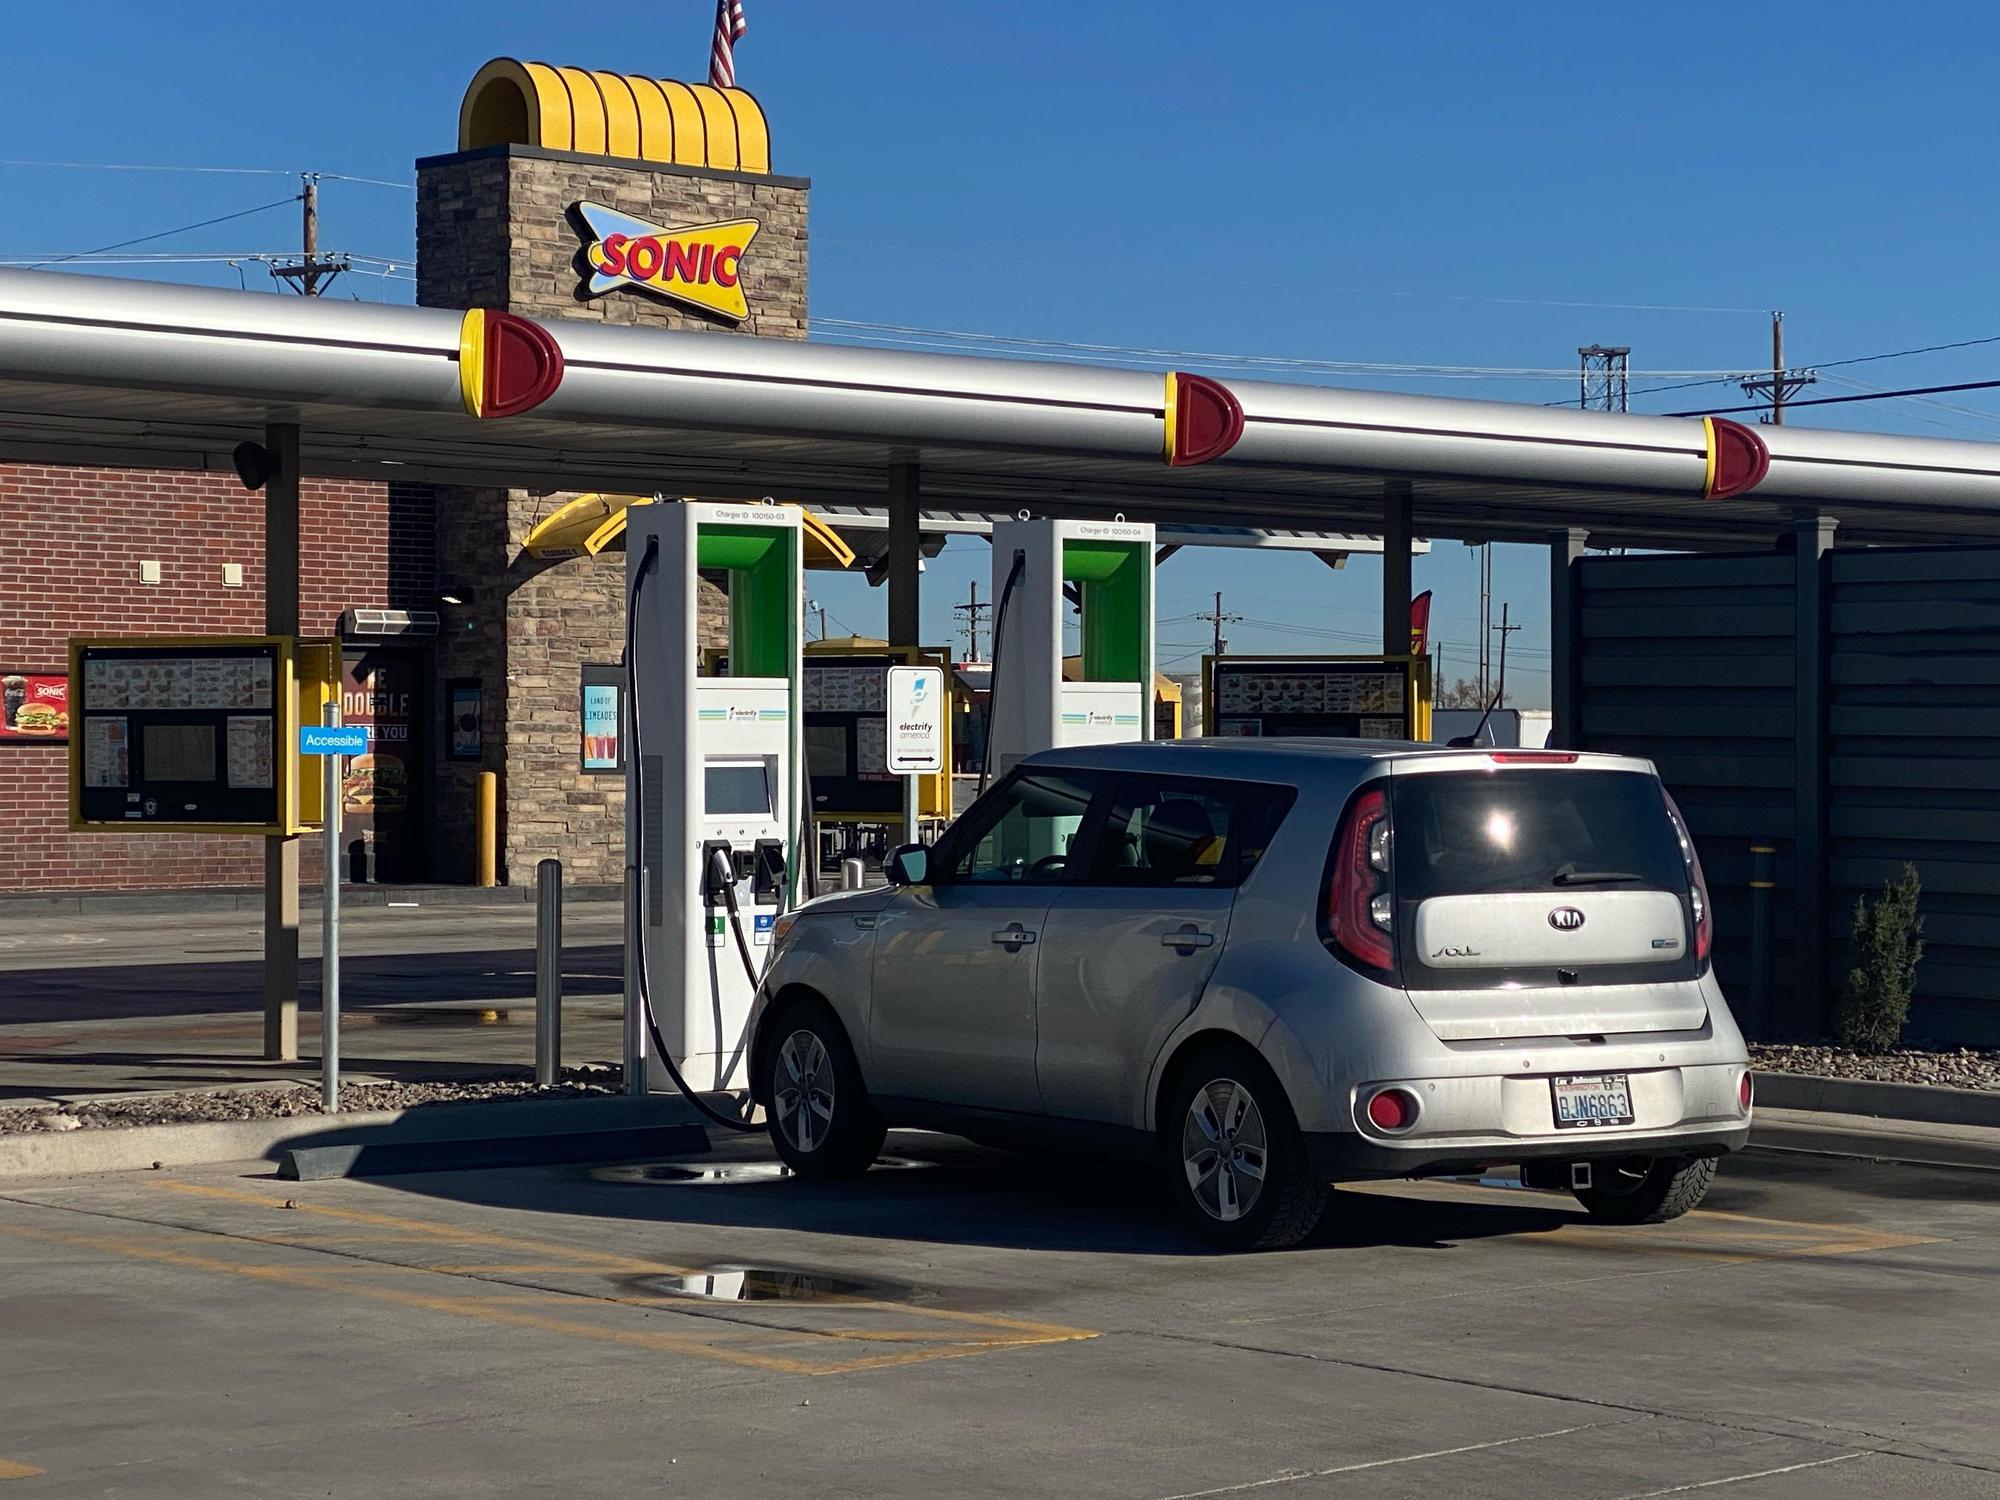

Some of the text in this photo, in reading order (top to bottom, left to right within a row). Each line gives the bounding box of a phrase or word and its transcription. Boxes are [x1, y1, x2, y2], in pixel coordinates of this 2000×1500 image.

[597, 232, 741, 288] SONIC
[716, 510, 741, 519] Charger
[1080, 527, 1102, 535] Charger
[37, 687, 65, 696] SONIC
[343, 691, 409, 717] DOUBLE
[591, 697, 604, 705] LAND
[585, 711, 617, 721] LIMEADES
[382, 726, 408, 739] YOU
[899, 722, 933, 733] electrify
[305, 734, 363, 747] Accessible
[1555, 912, 1582, 927] KIA
[1559, 1093, 1628, 1120] BJN6863
